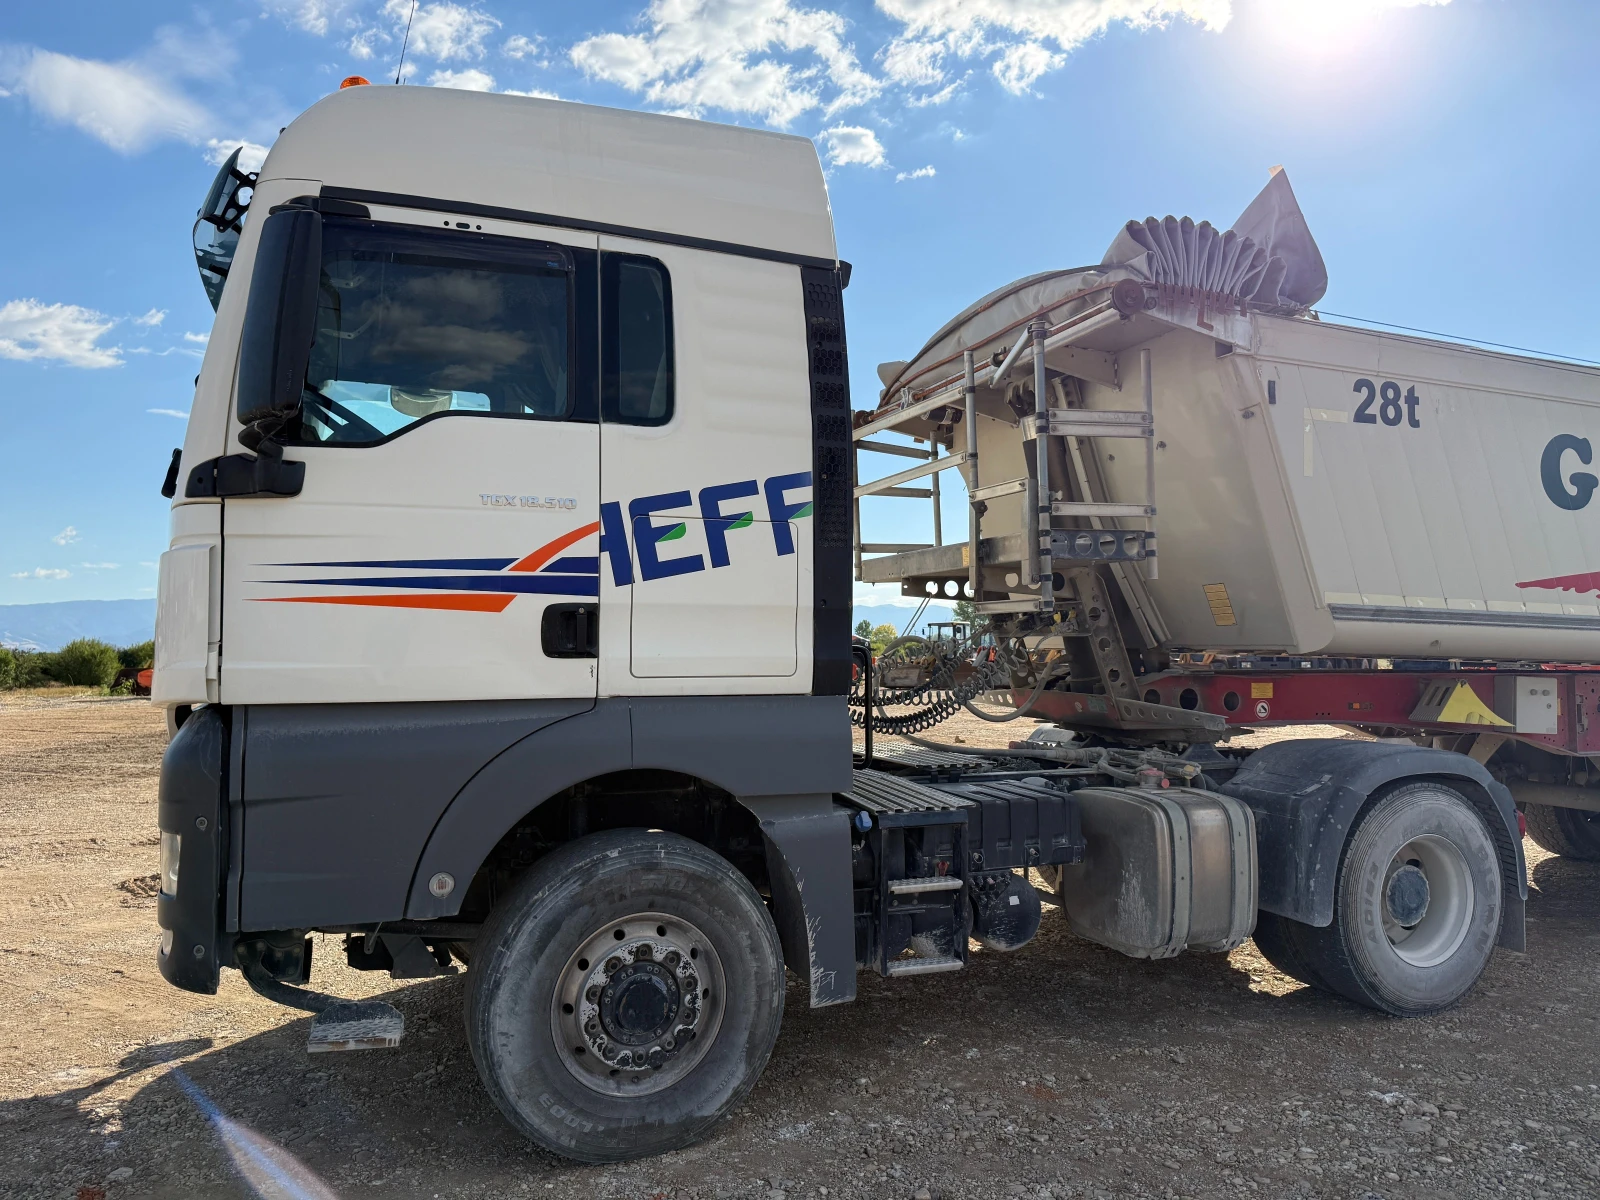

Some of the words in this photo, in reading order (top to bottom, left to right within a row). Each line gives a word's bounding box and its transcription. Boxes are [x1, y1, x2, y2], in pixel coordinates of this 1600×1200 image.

[1352, 377, 1421, 429] 28t
[1540, 433, 1599, 511] G
[479, 493, 517, 507] TGX
[519, 495, 577, 510] 18.510
